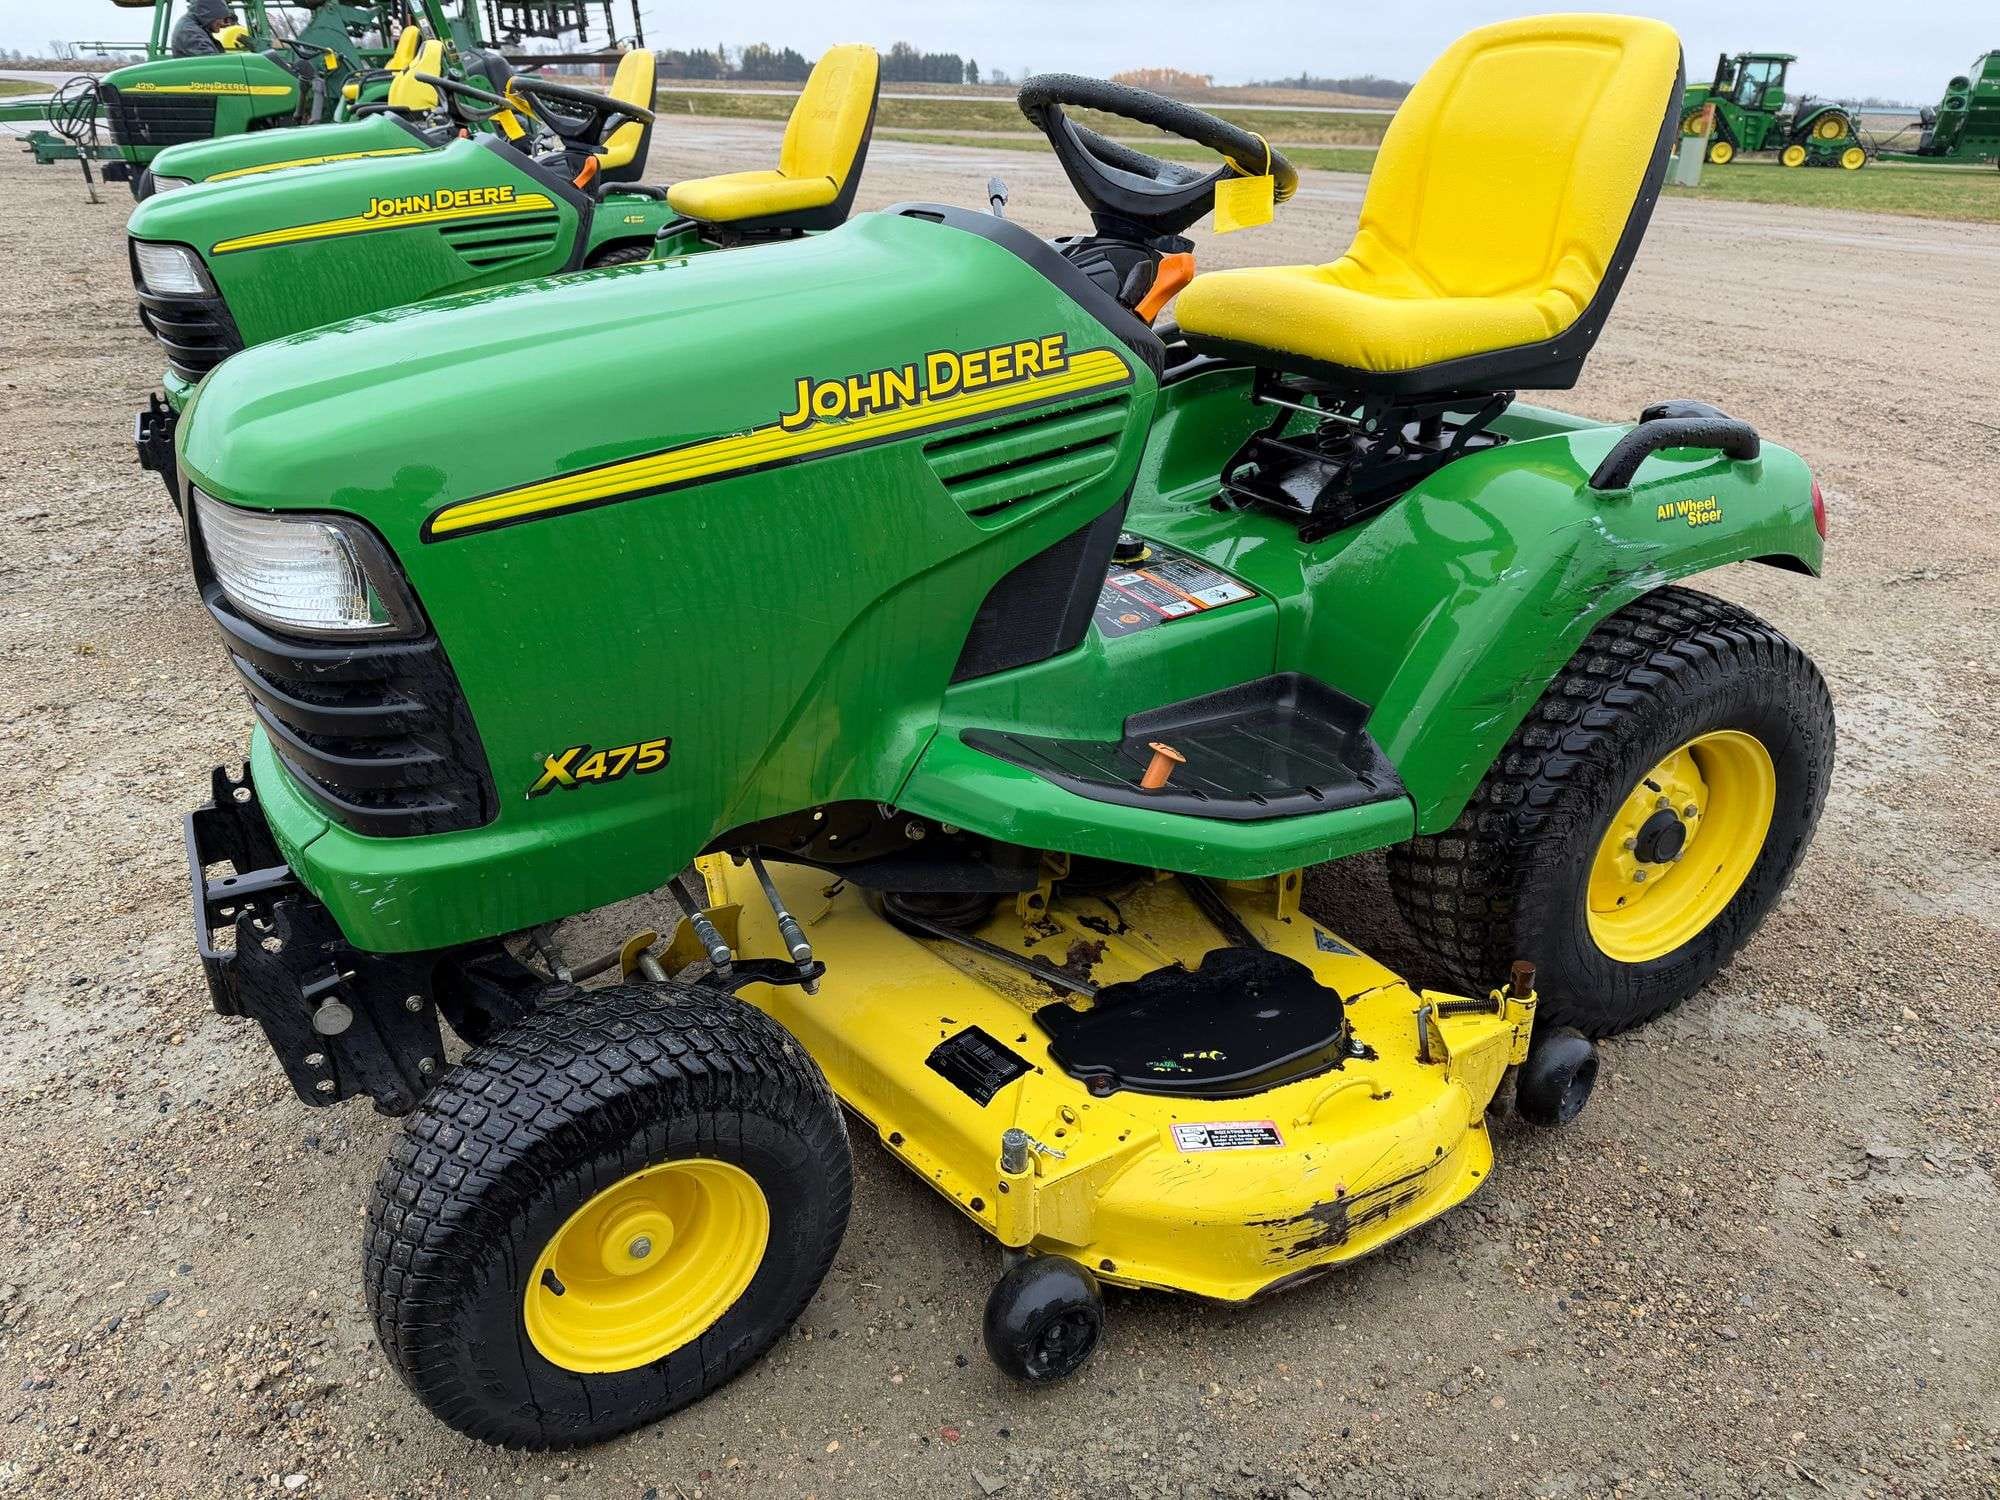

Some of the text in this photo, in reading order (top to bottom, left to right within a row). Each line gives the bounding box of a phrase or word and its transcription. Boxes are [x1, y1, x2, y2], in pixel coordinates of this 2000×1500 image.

[190, 81, 249, 92] JOHN DEERE
[363, 186, 515, 219] JOHN DEERE
[780, 333, 1068, 431] JOHN DEERE
[1657, 495, 1717, 521] All Wheel
[1687, 508, 1722, 527] Steer
[527, 737, 670, 796] X475
